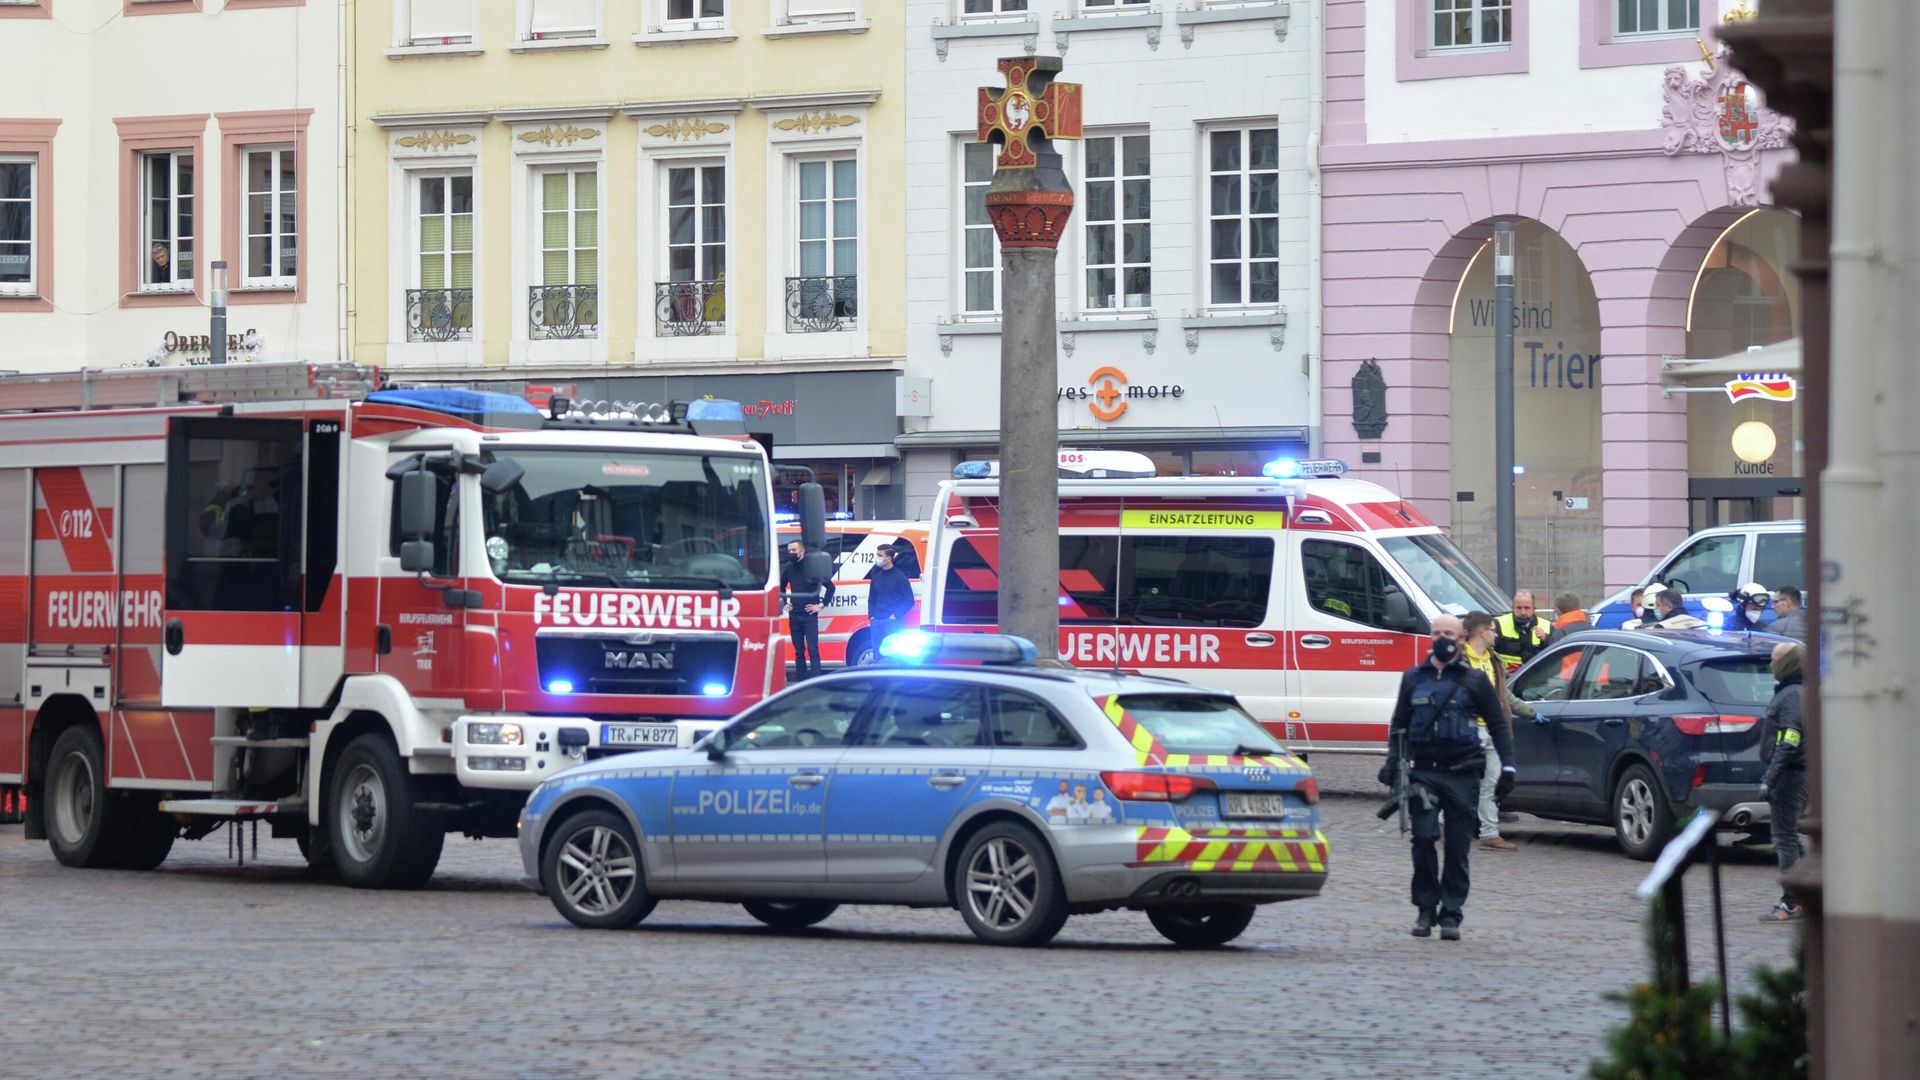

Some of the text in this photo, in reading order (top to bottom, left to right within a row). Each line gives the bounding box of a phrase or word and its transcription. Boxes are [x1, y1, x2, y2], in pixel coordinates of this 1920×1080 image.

[1471, 300, 1553, 329] Wi sind
[1523, 341, 1601, 389] Trier
[1057, 384, 1182, 402] yes more
[1060, 454, 1084, 463] BOS
[1301, 462, 1342, 474] FEUERWEHR
[1734, 461, 1774, 475] Kunde
[72, 508, 93, 538] 112
[1149, 513, 1255, 526] EINSATZLEITUNG
[861, 552, 875, 564] 112
[48, 590, 162, 628] FEUERWEHR
[533, 592, 741, 629] FEUERWEHR
[1058, 632, 1220, 663] UERWEHR
[604, 651, 674, 669] MAN
[611, 727, 676, 742] TR FW 877
